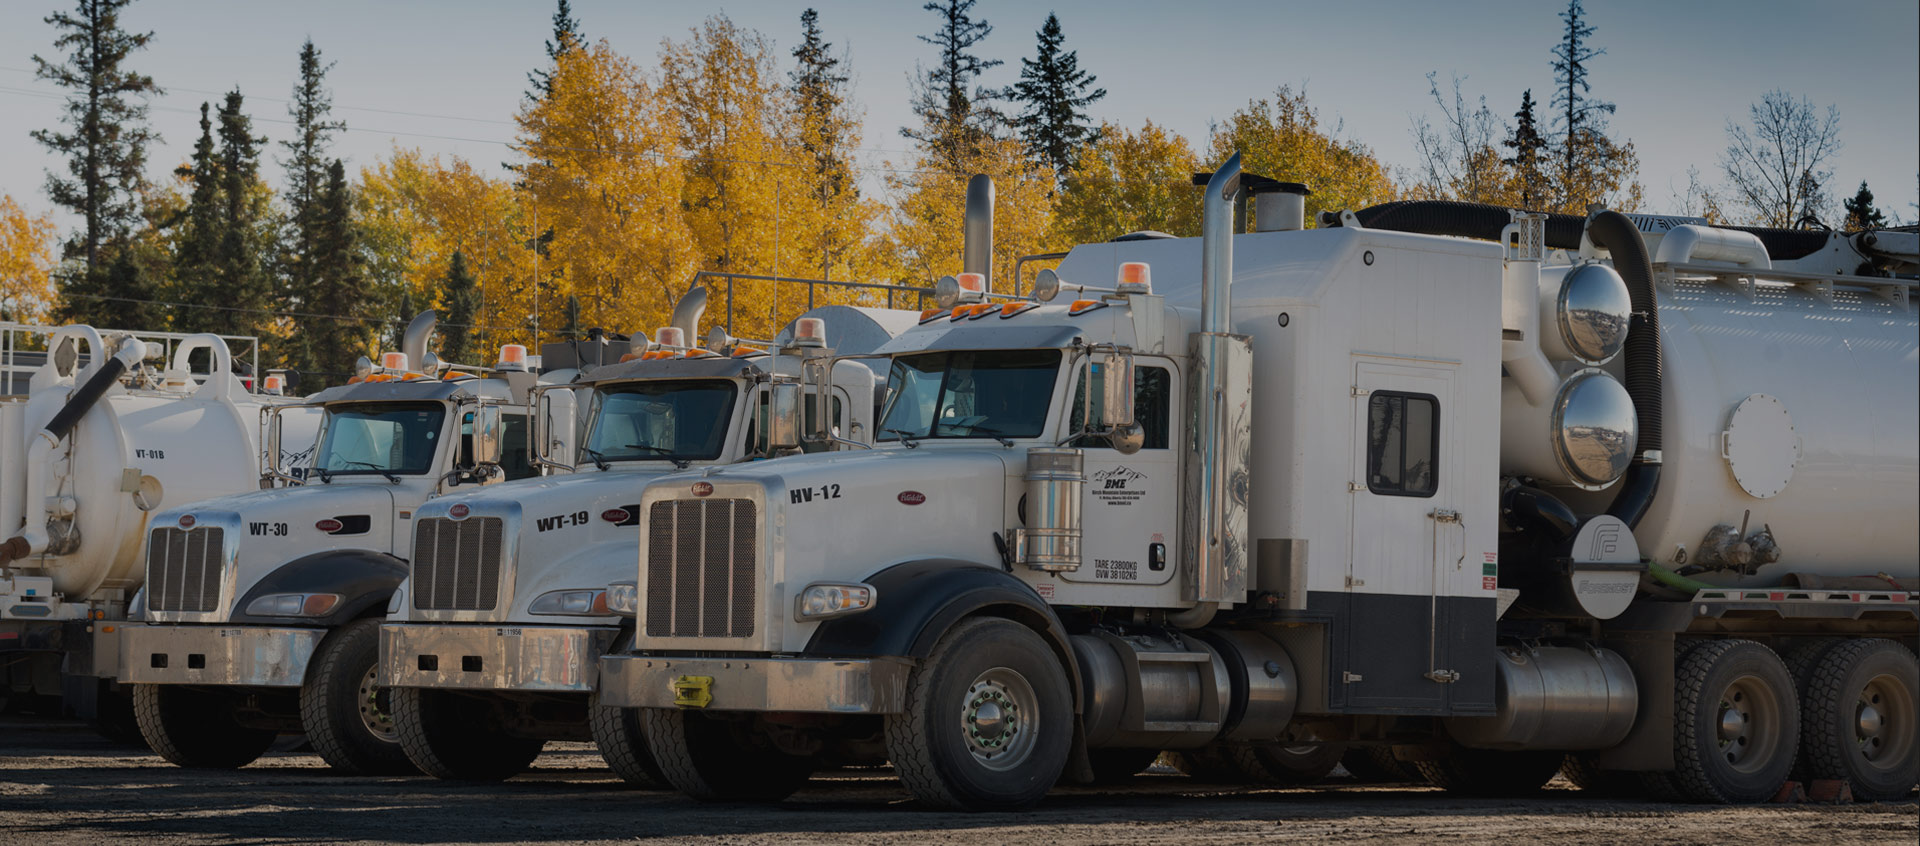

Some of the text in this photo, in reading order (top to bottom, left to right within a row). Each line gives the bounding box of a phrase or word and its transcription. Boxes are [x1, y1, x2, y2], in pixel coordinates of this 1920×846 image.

[135, 449, 165, 460] VT-01B
[1104, 478, 1127, 489] BME
[789, 483, 842, 504] HV-12
[537, 510, 589, 533] WT-19
[249, 522, 288, 537] WT-30
[1095, 559, 1138, 571] TARE 23800KG
[1095, 569, 1138, 581] GVW 38102KG
